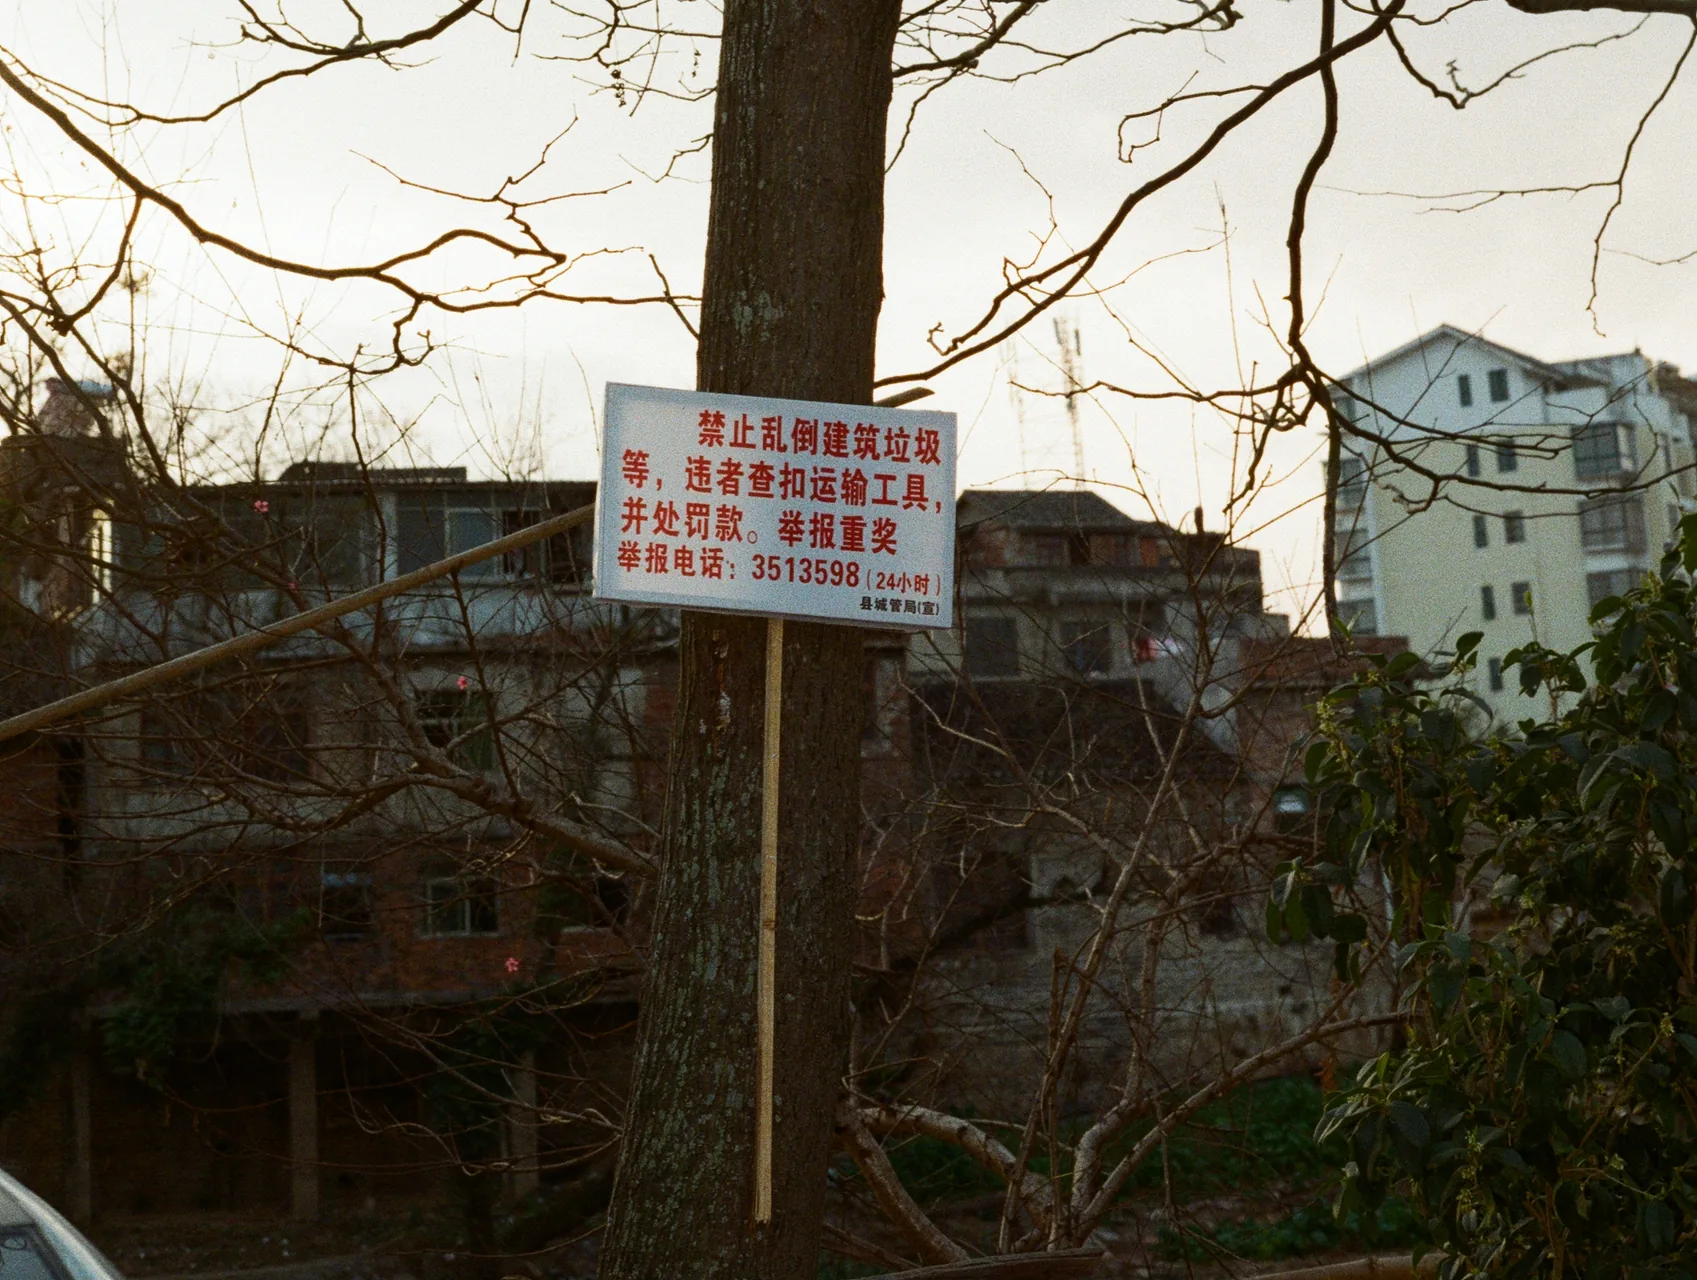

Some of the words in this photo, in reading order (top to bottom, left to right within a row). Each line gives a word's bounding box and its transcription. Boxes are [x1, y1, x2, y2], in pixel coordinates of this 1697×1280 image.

[698, 409, 942, 466] 禁止乱倒建筑垃圾
